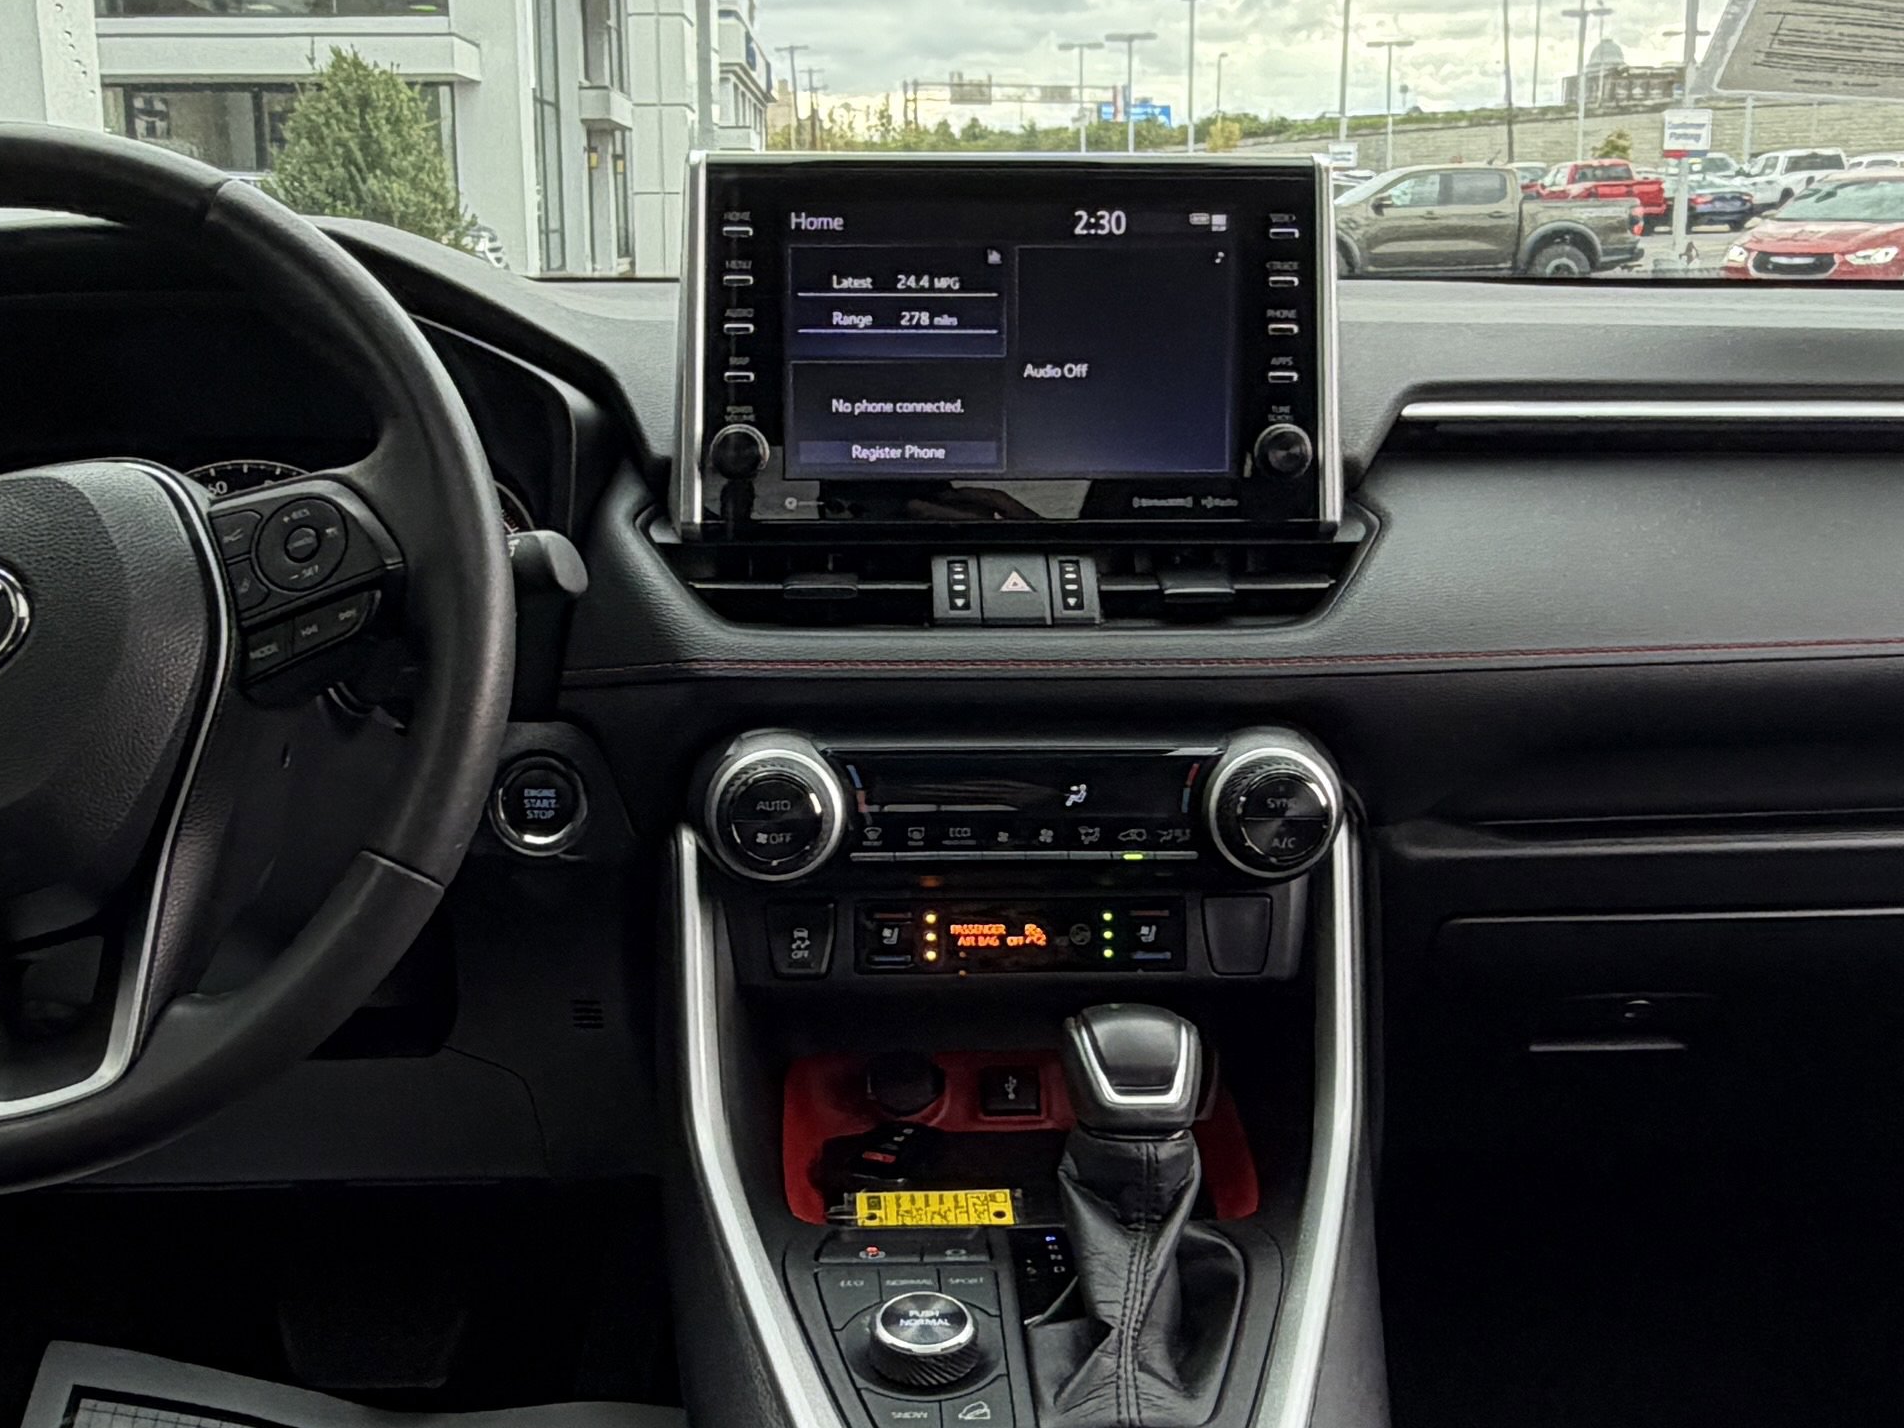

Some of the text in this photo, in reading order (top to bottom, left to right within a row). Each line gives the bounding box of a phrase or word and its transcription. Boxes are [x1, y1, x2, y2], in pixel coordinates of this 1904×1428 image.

[790, 212, 844, 231] Home
[1073, 210, 1127, 235] 2:30
[832, 275, 960, 290] Latest 24.4 MPG
[1266, 309, 1297, 318] PHONE
[832, 312, 873, 328] Range
[900, 312, 930, 326] 278
[1023, 363, 1089, 378] Audio Off
[832, 399, 965, 416] No phone connected.
[851, 444, 946, 462] Register Phone
[524, 799, 557, 808] START
[756, 801, 791, 811] AUTO
[526, 810, 555, 819] STOP
[769, 833, 793, 844] OFF
[1271, 837, 1296, 849] A/C
[950, 924, 1006, 934] PASSENGER
[957, 936, 1024, 946] AIR BAG OFF
[909, 1310, 940, 1318] PUSH
[899, 1318, 950, 1326] NORMAL
